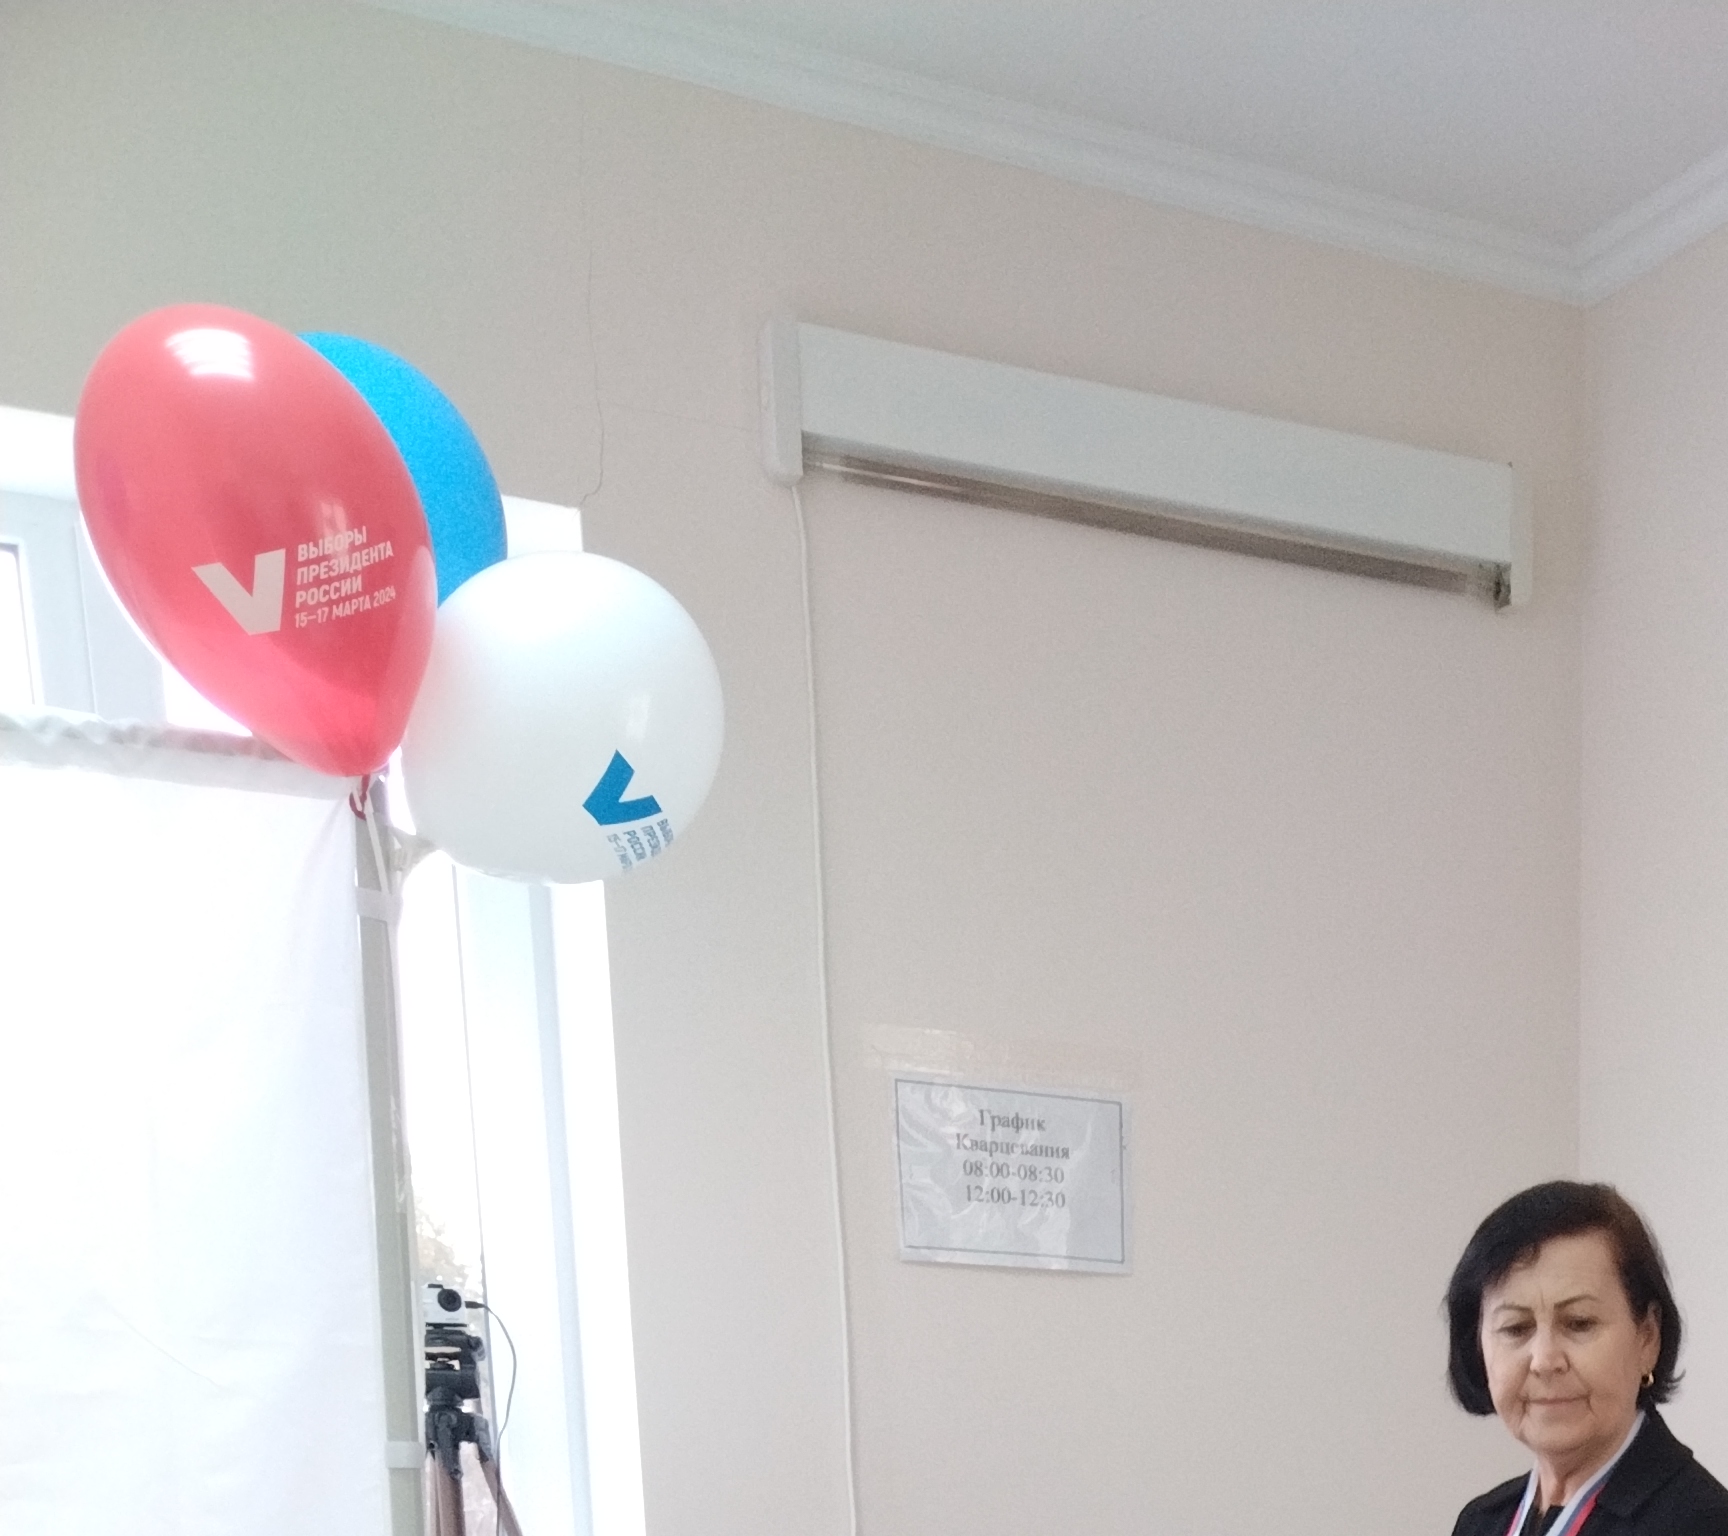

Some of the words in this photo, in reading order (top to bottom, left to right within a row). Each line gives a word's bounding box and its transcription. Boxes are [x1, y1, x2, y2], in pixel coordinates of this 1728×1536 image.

[298, 525, 367, 562] ВЫБОРЫ
[296, 541, 394, 586] ПРЕЗИДЕНТА
[295, 574, 363, 609] РОССИИ
[332, 595, 371, 621] МАРТА
[373, 585, 397, 608] 2024
[979, 1108, 1046, 1134] График
[962, 1158, 1065, 1184] 08:00-08:30
[966, 1184, 1066, 1208] 12:00-12:30
